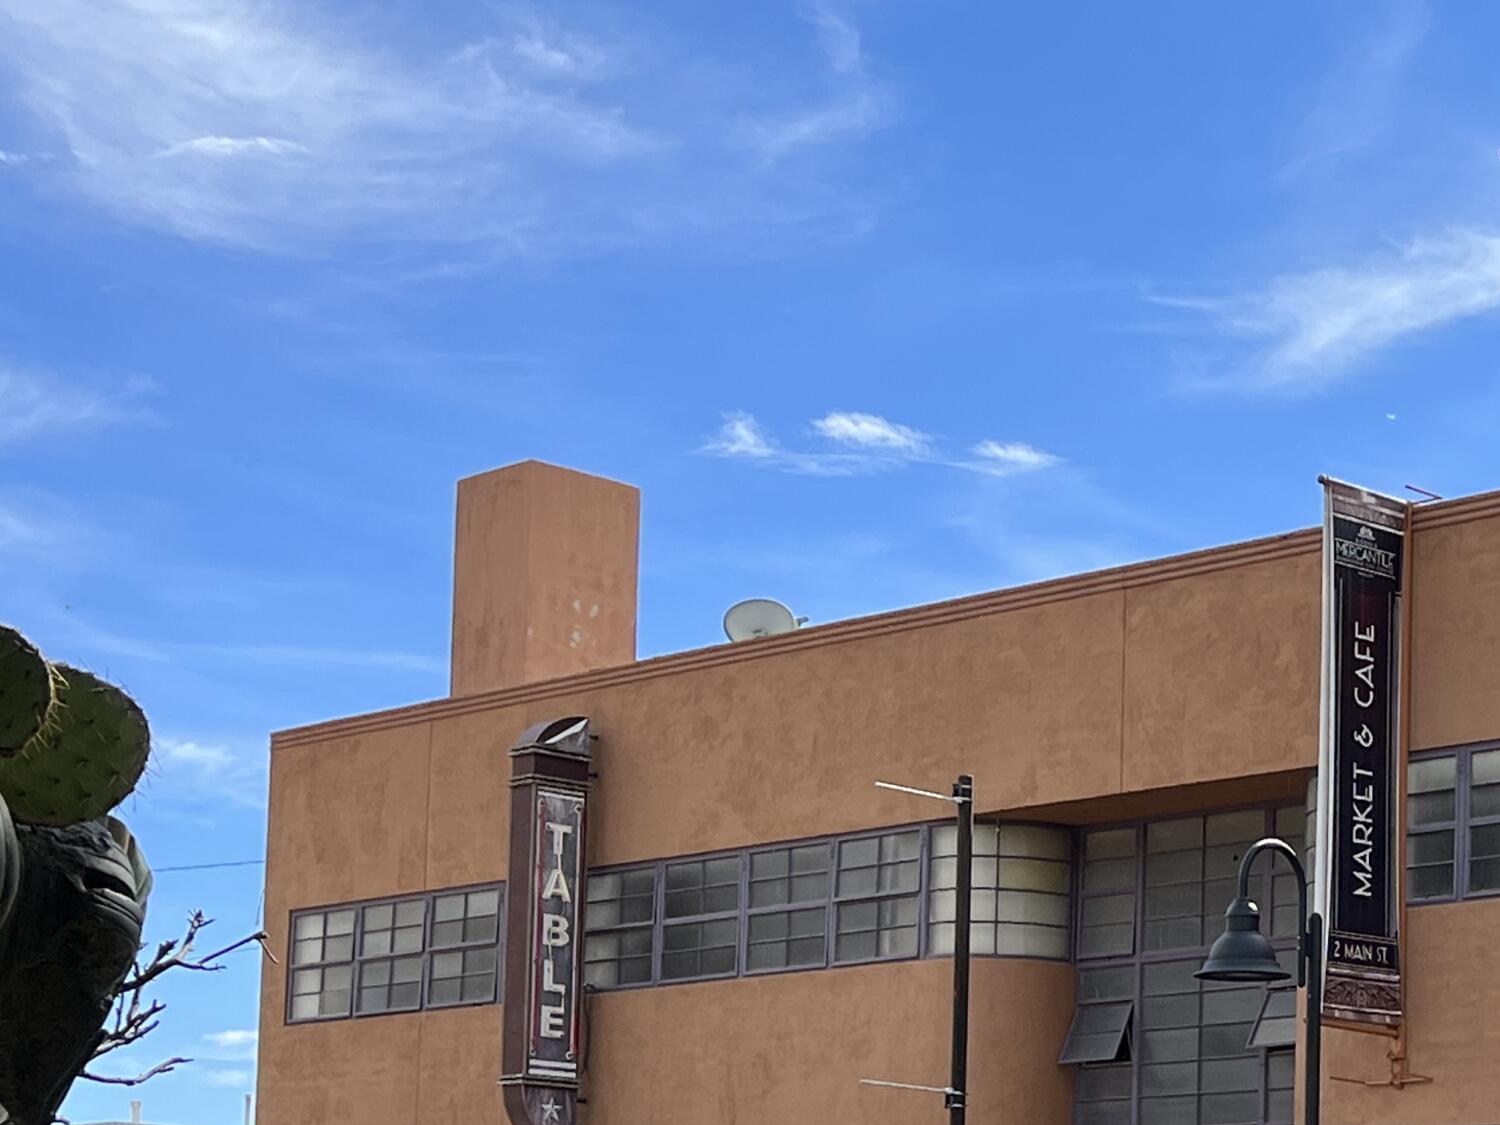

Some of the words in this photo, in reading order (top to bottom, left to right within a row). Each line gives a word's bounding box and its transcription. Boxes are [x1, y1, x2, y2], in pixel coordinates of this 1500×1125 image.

[1353, 620, 1375, 708] CAFE
[1353, 722, 1374, 748] &
[1353, 762, 1374, 898] MARKET
[541, 822, 573, 1039] TABLE
[1333, 940, 1340, 958] 2
[1344, 943, 1373, 960] MAIN
